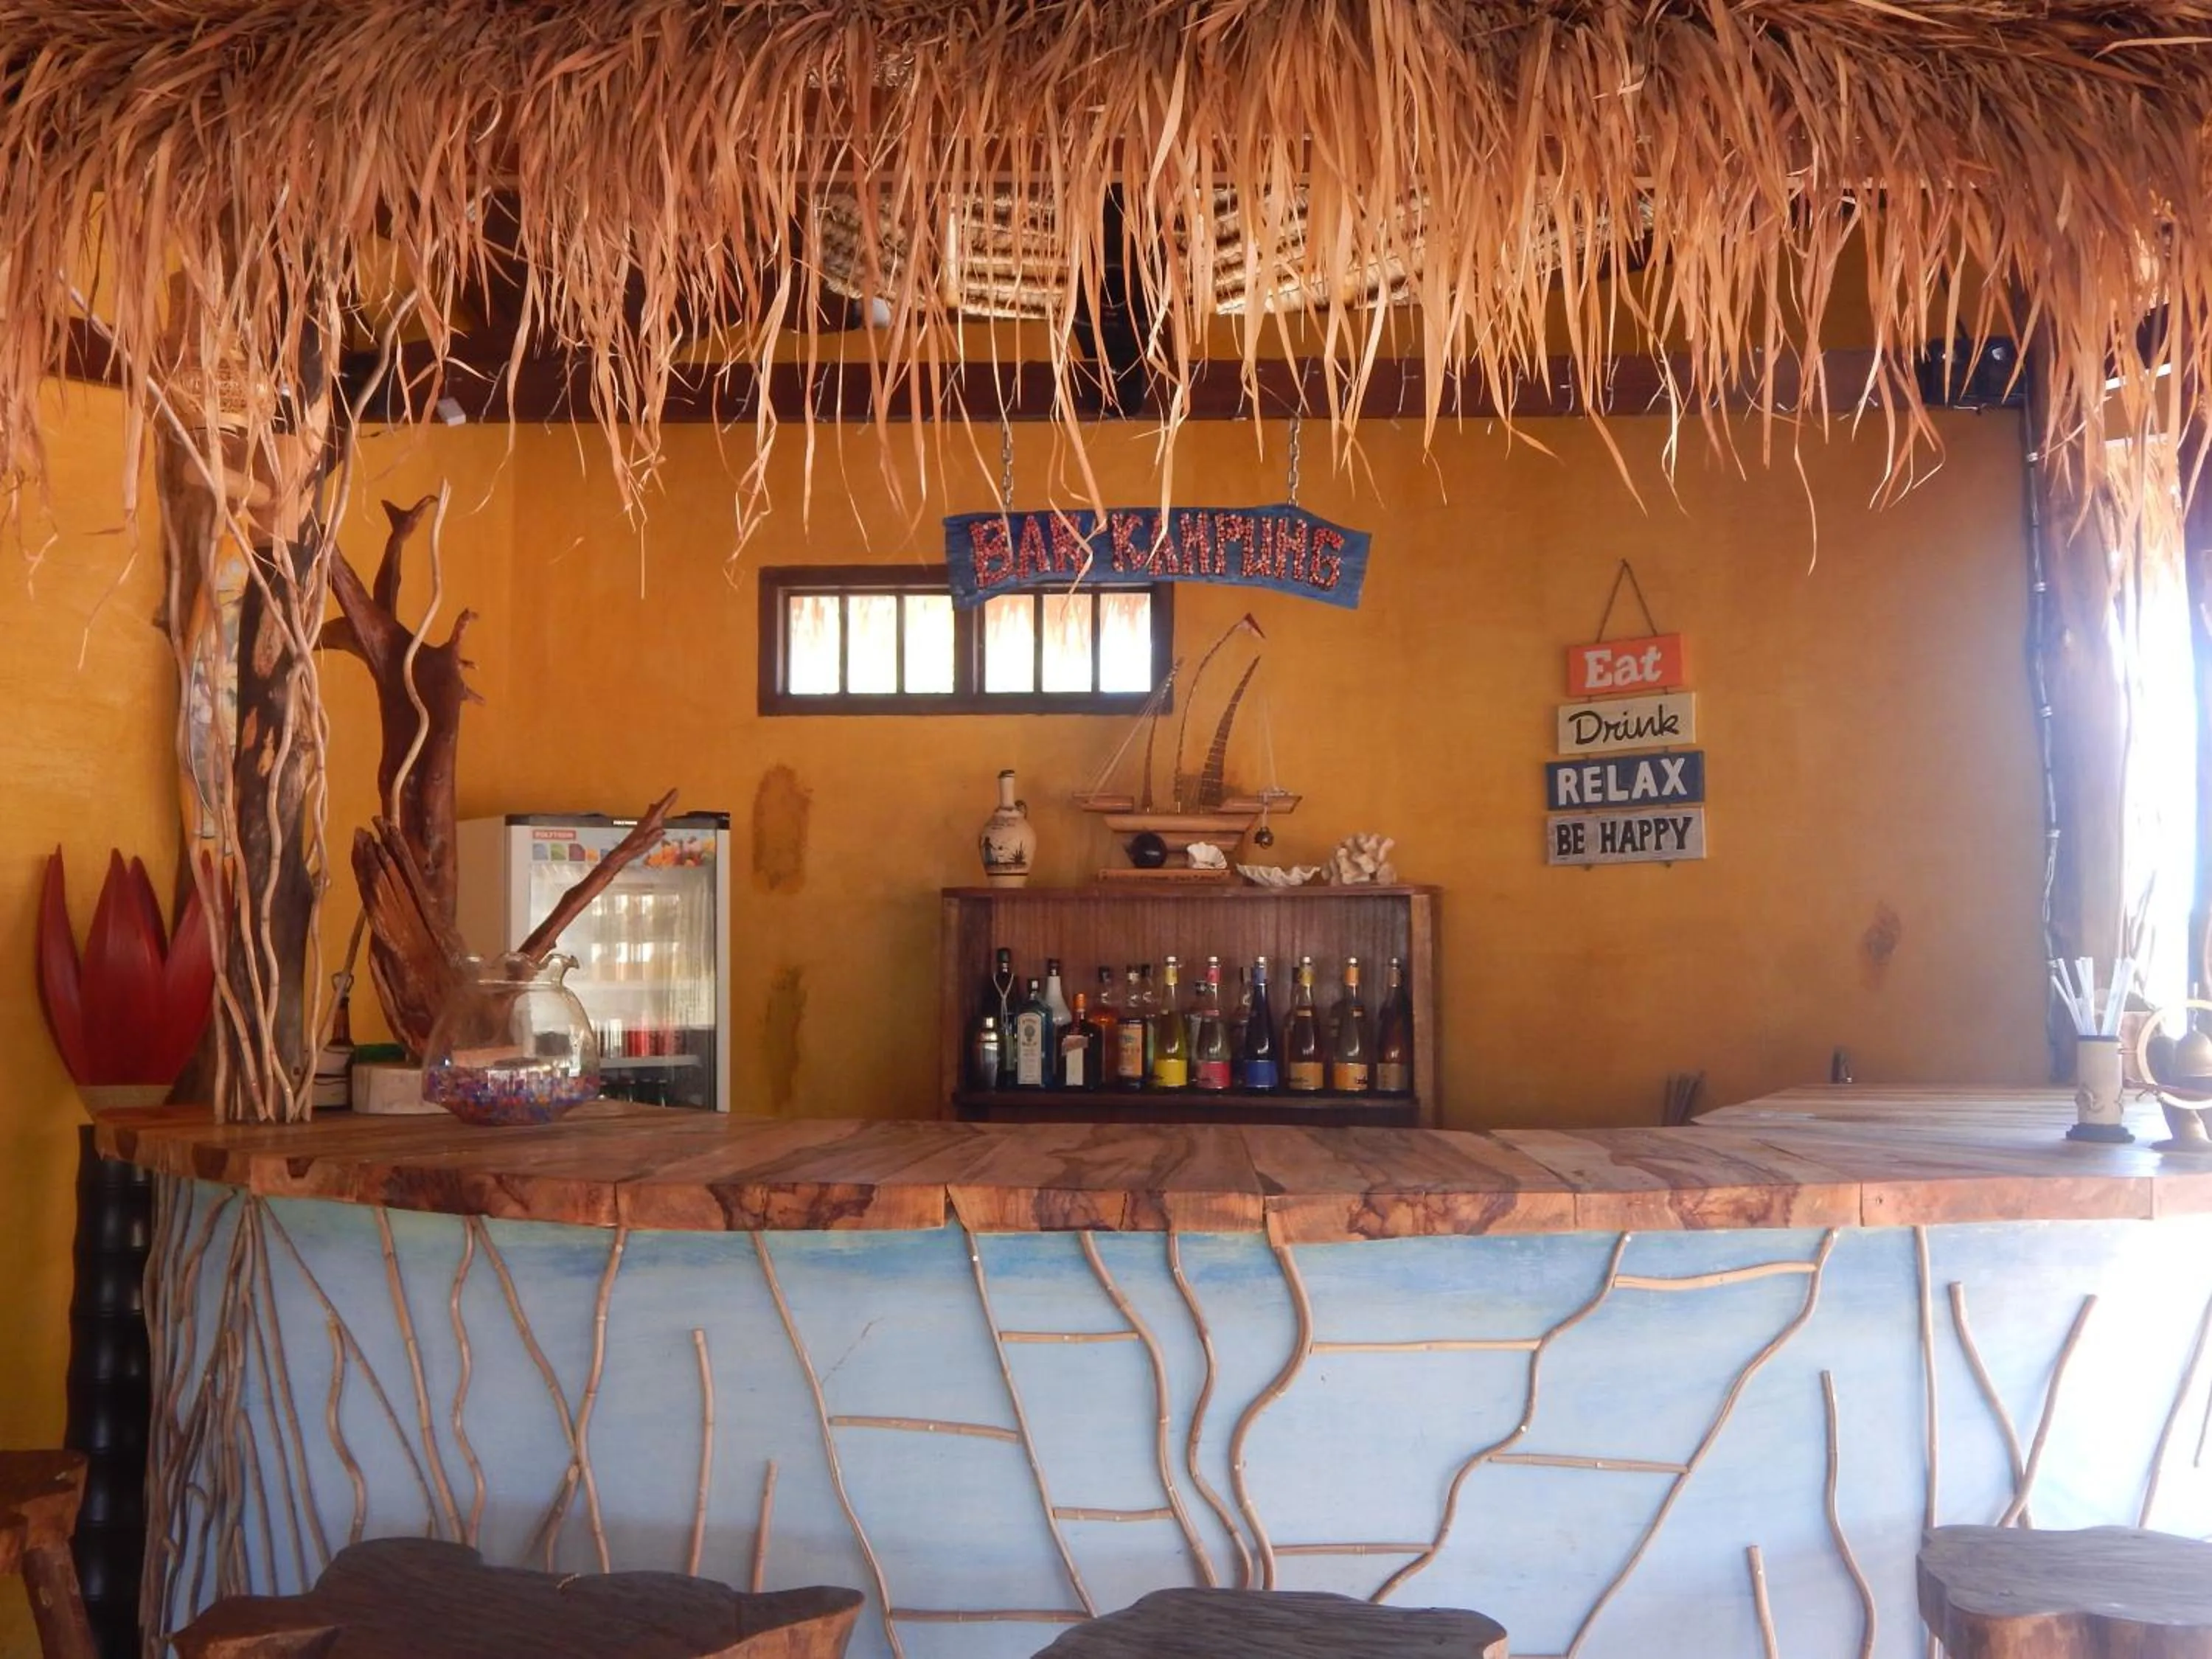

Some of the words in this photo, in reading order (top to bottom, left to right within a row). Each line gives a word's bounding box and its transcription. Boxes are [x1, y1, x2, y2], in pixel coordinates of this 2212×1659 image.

[970, 512, 1085, 588] BAR
[1112, 512, 1344, 590] KAMPUNG
[1585, 644, 1663, 690] Eat
[1568, 704, 1680, 745] Drink
[1557, 757, 1688, 806] RELAX
[1557, 823, 1585, 855] BE
[1600, 817, 1693, 854] HAPPY
